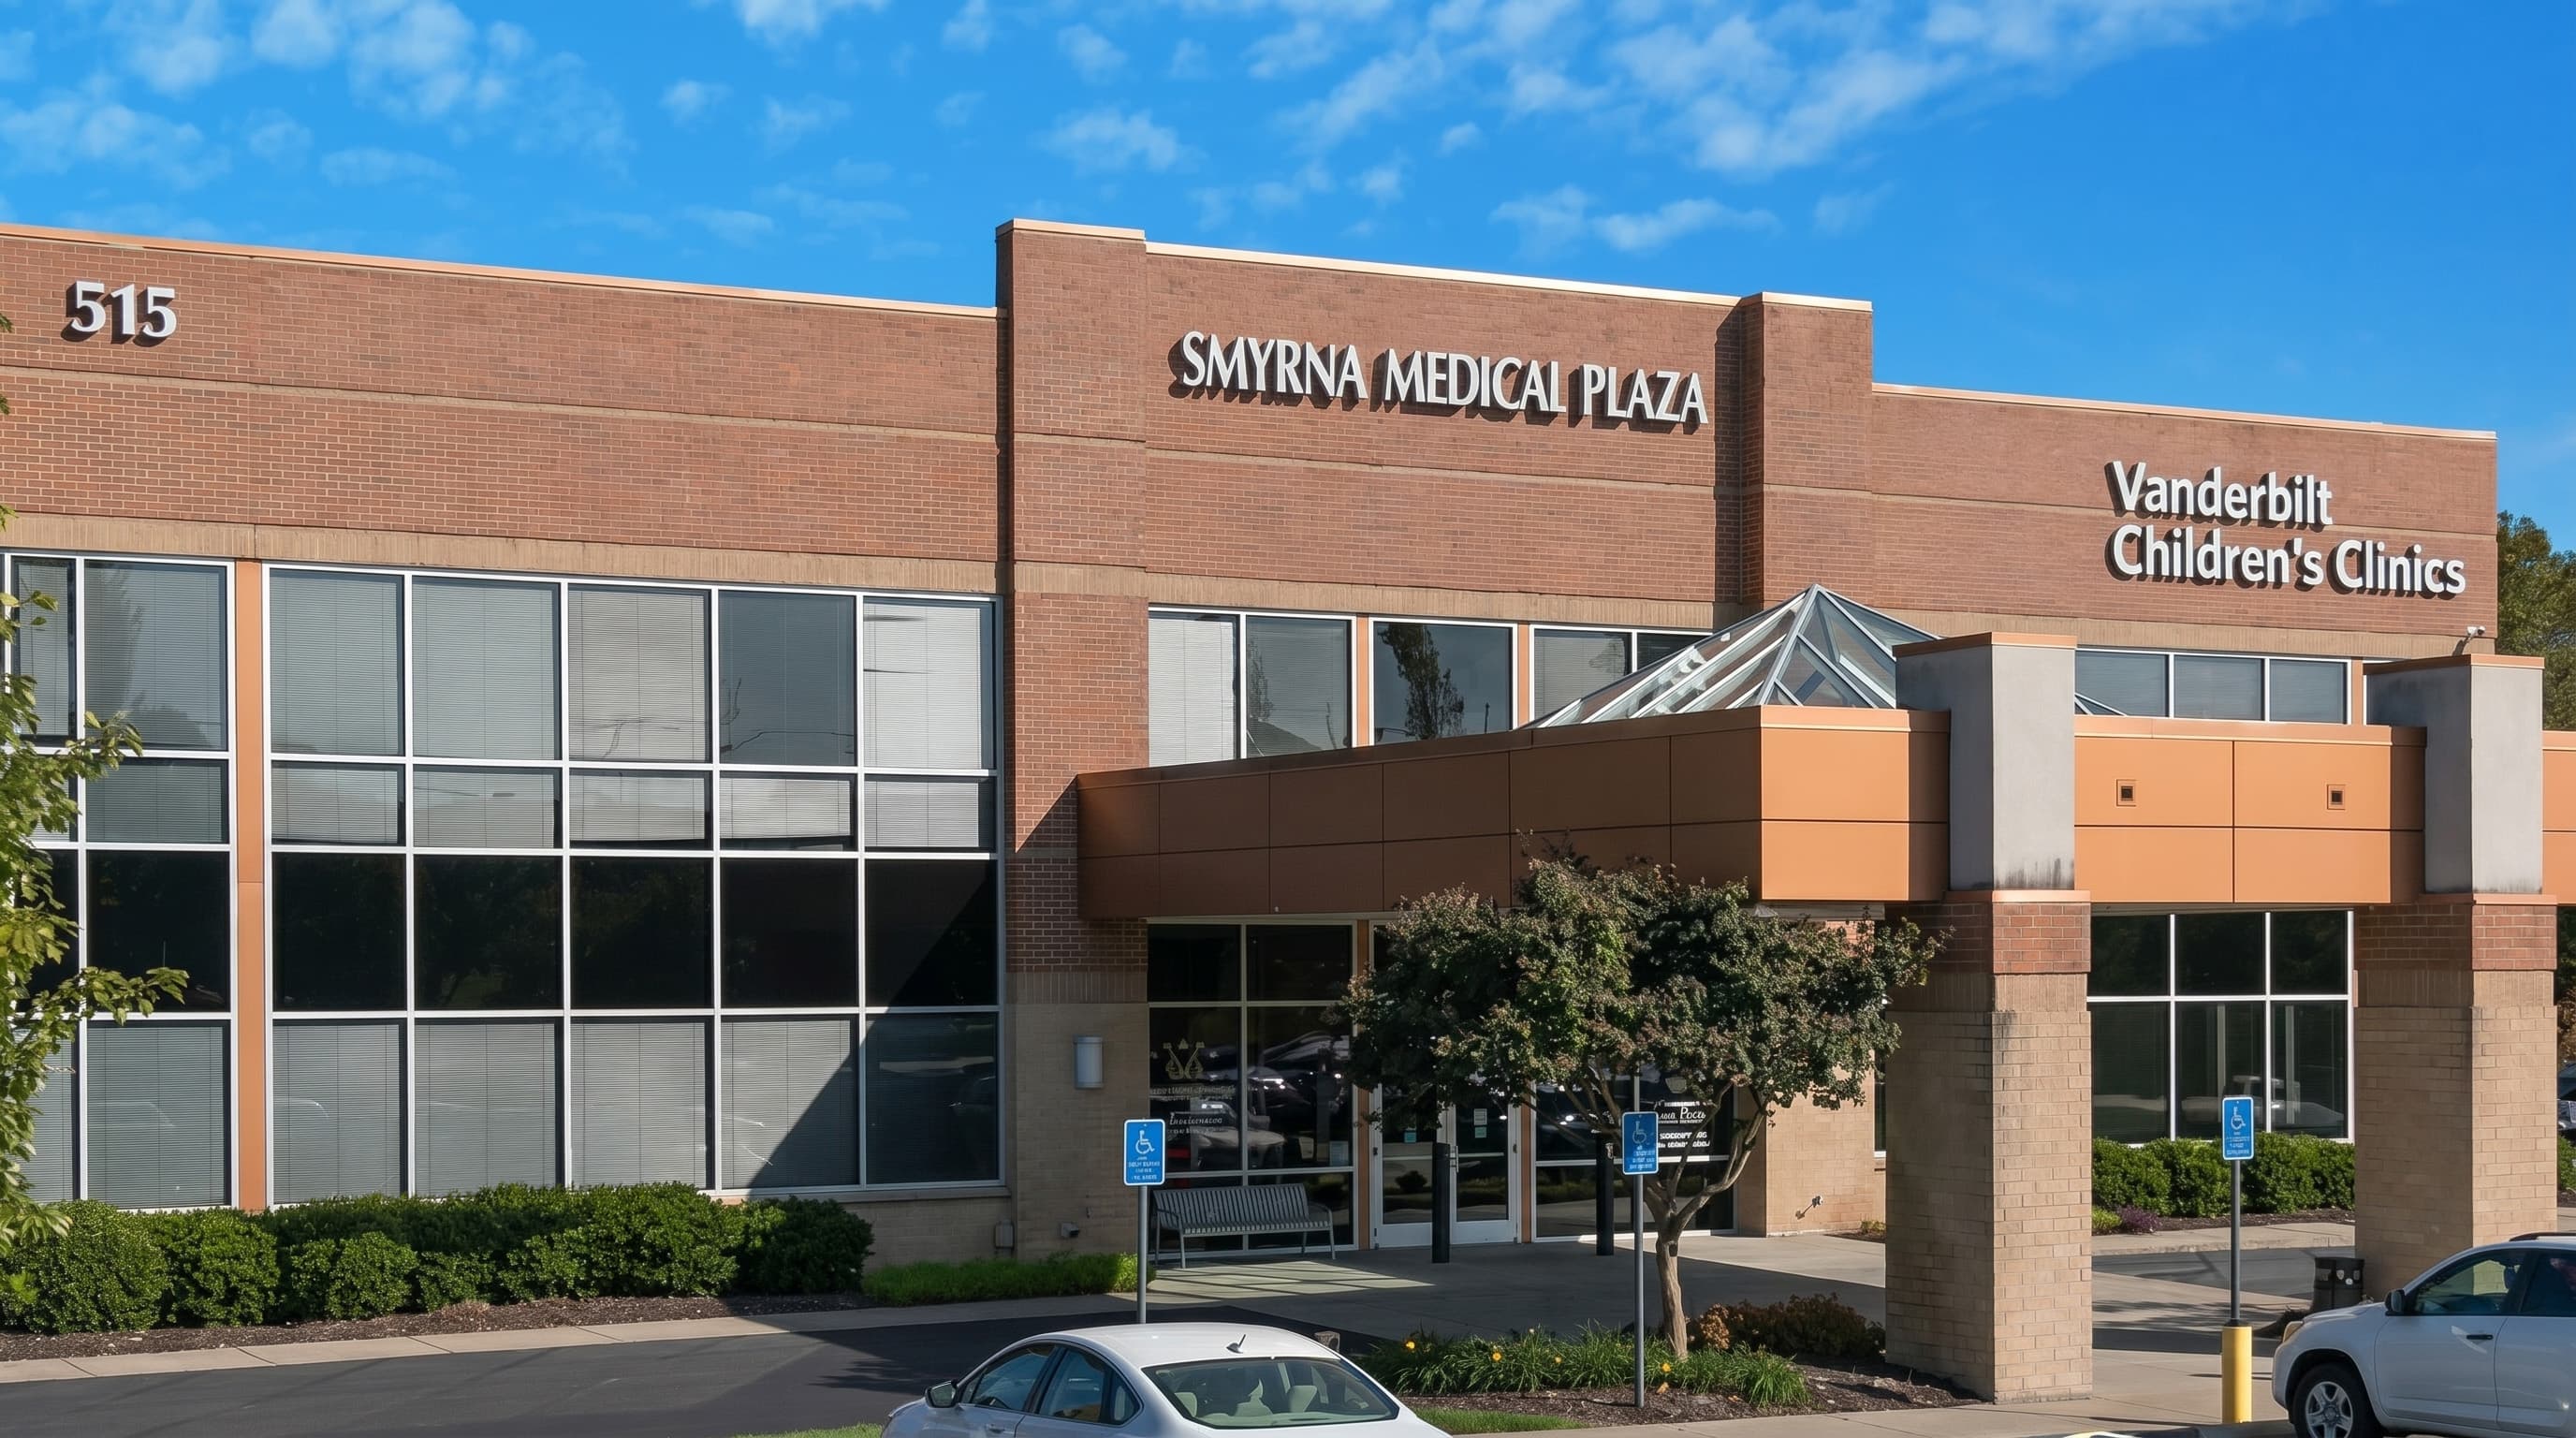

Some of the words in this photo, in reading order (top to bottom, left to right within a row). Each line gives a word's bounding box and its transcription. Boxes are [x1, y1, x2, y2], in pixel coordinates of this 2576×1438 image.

[70, 280, 177, 338] 515
[1181, 330, 1368, 400] SMYRNA
[1383, 347, 1567, 414] MEDICAL
[1582, 362, 1708, 424] PLAZA
[2112, 460, 2333, 525] Vanderbilt
[2113, 523, 2324, 586] Children's
[2335, 539, 2466, 594] Clinics
